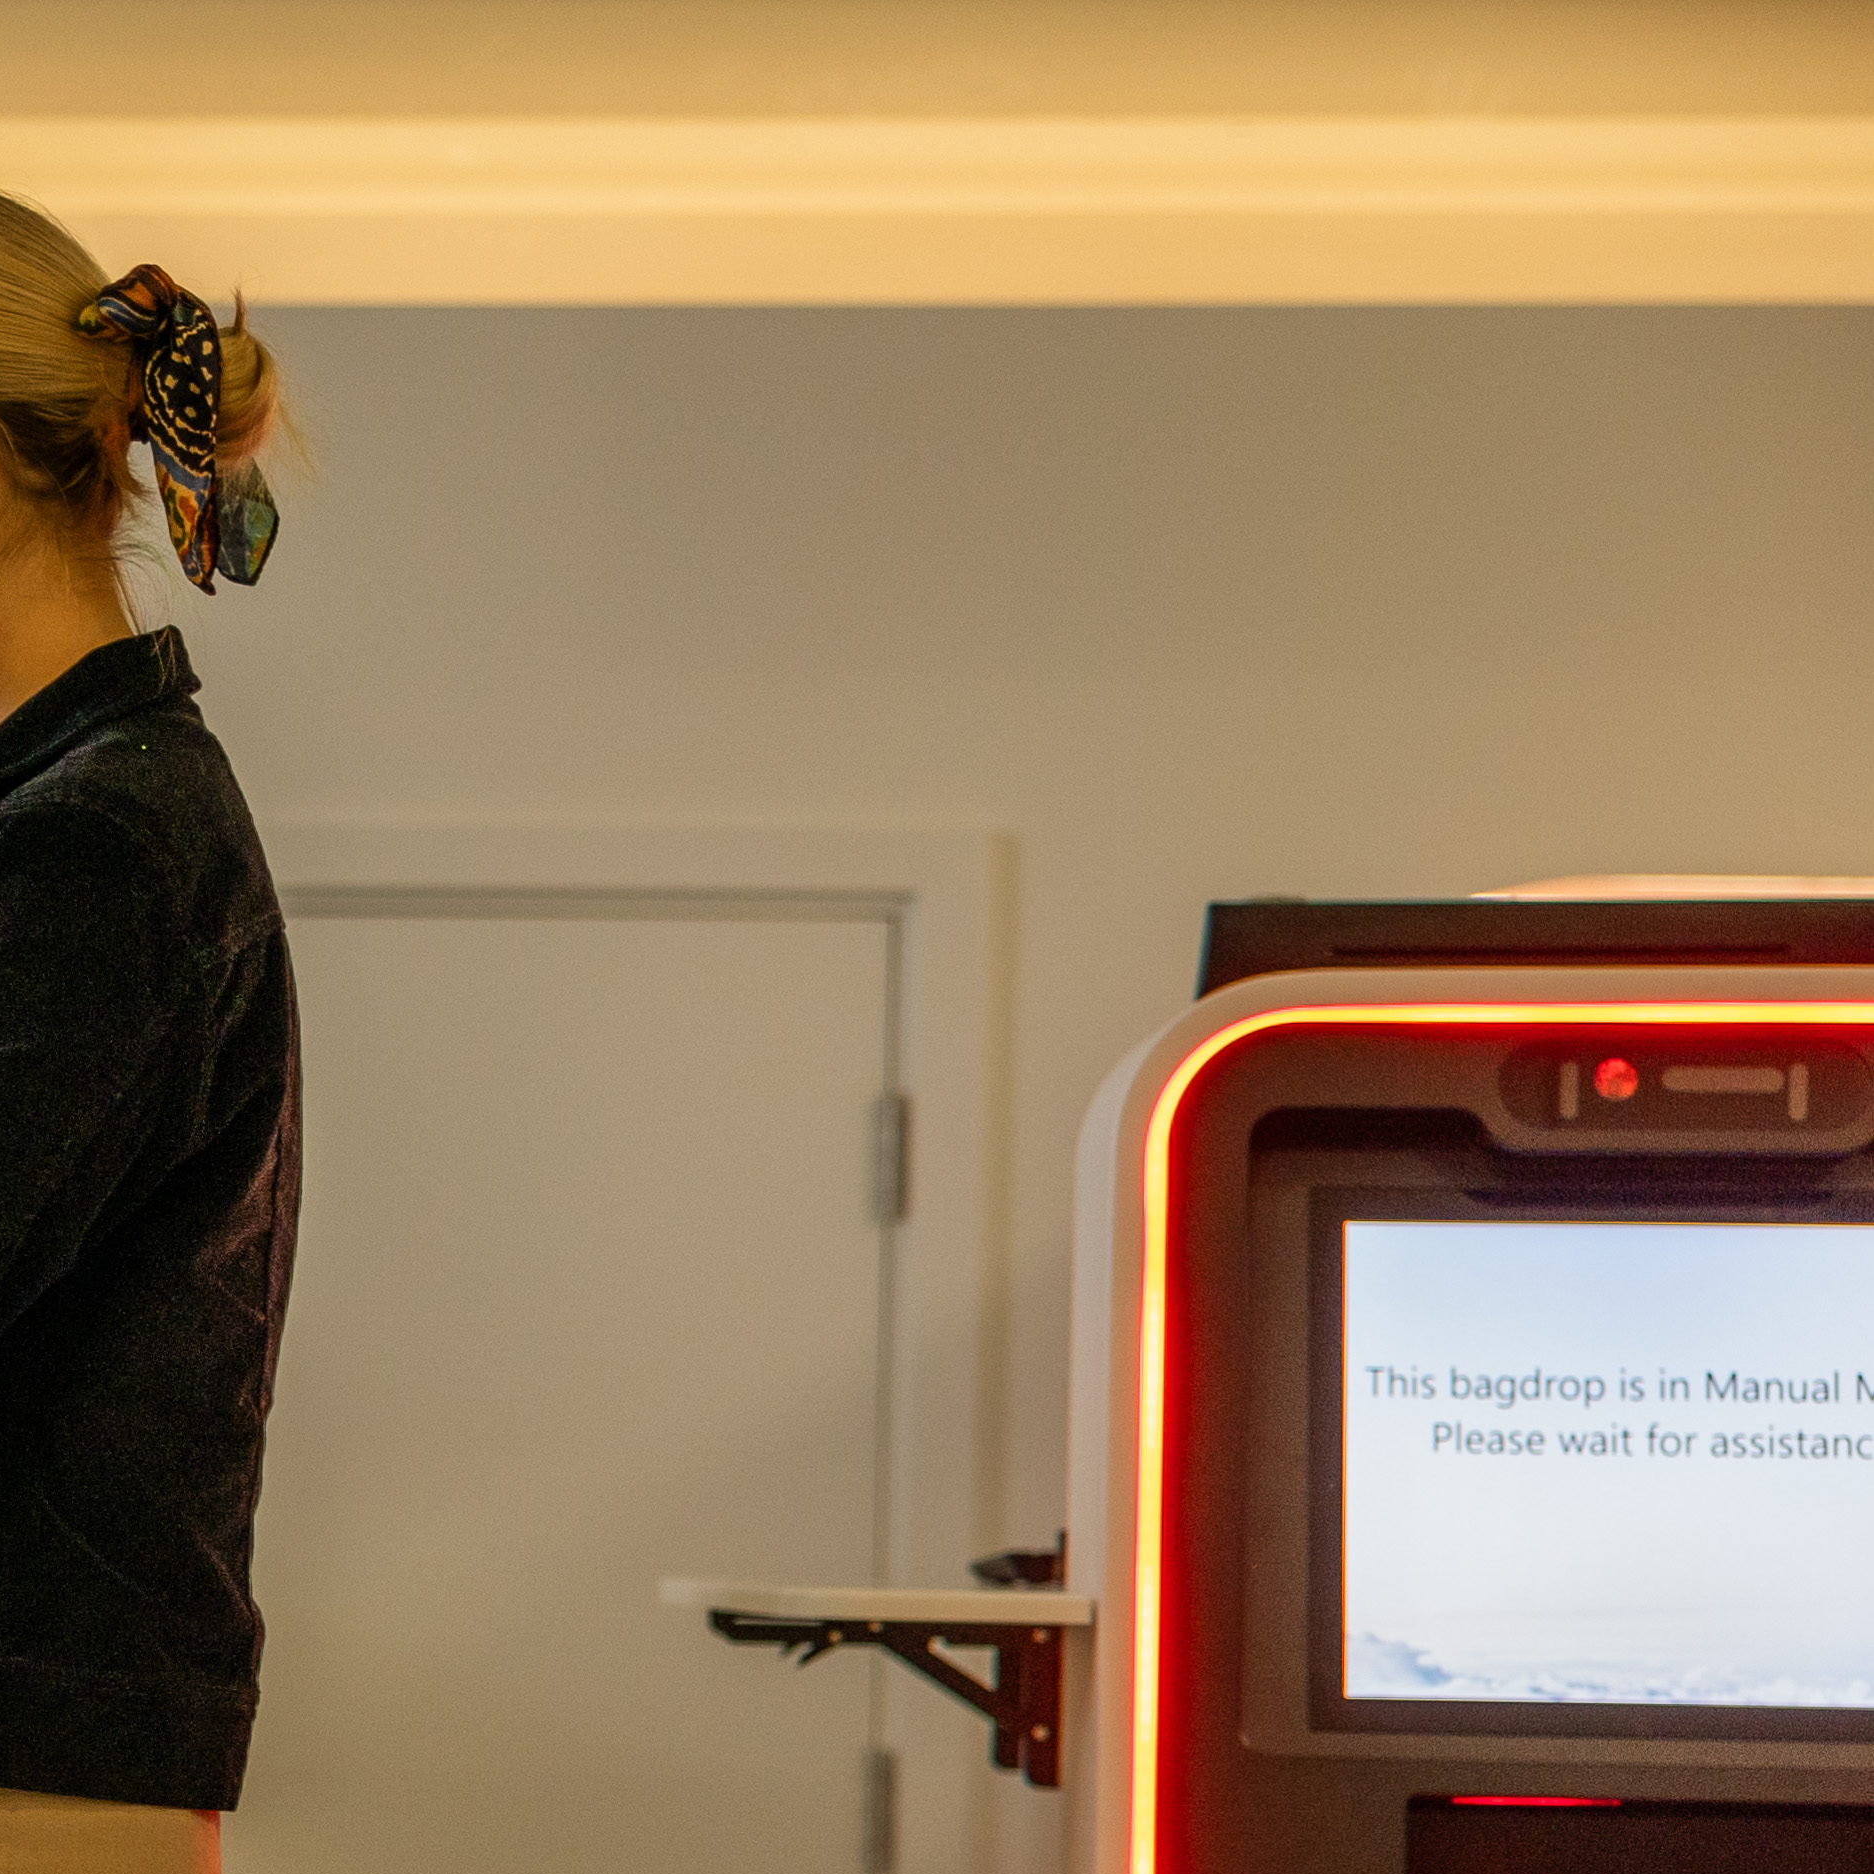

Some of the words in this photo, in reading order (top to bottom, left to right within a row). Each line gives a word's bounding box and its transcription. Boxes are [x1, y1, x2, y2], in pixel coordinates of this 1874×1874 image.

[1365, 1365, 1437, 1400] This
[1449, 1366, 1606, 1409] bagdrop
[1619, 1367, 1645, 1402] is
[1658, 1368, 1690, 1402] in
[1705, 1370, 1840, 1404] Manual
[1433, 1421, 1545, 1455] Please
[1558, 1422, 1632, 1457] wait
[1647, 1422, 1697, 1458] for
[1710, 1424, 1874, 1460] assistanc
